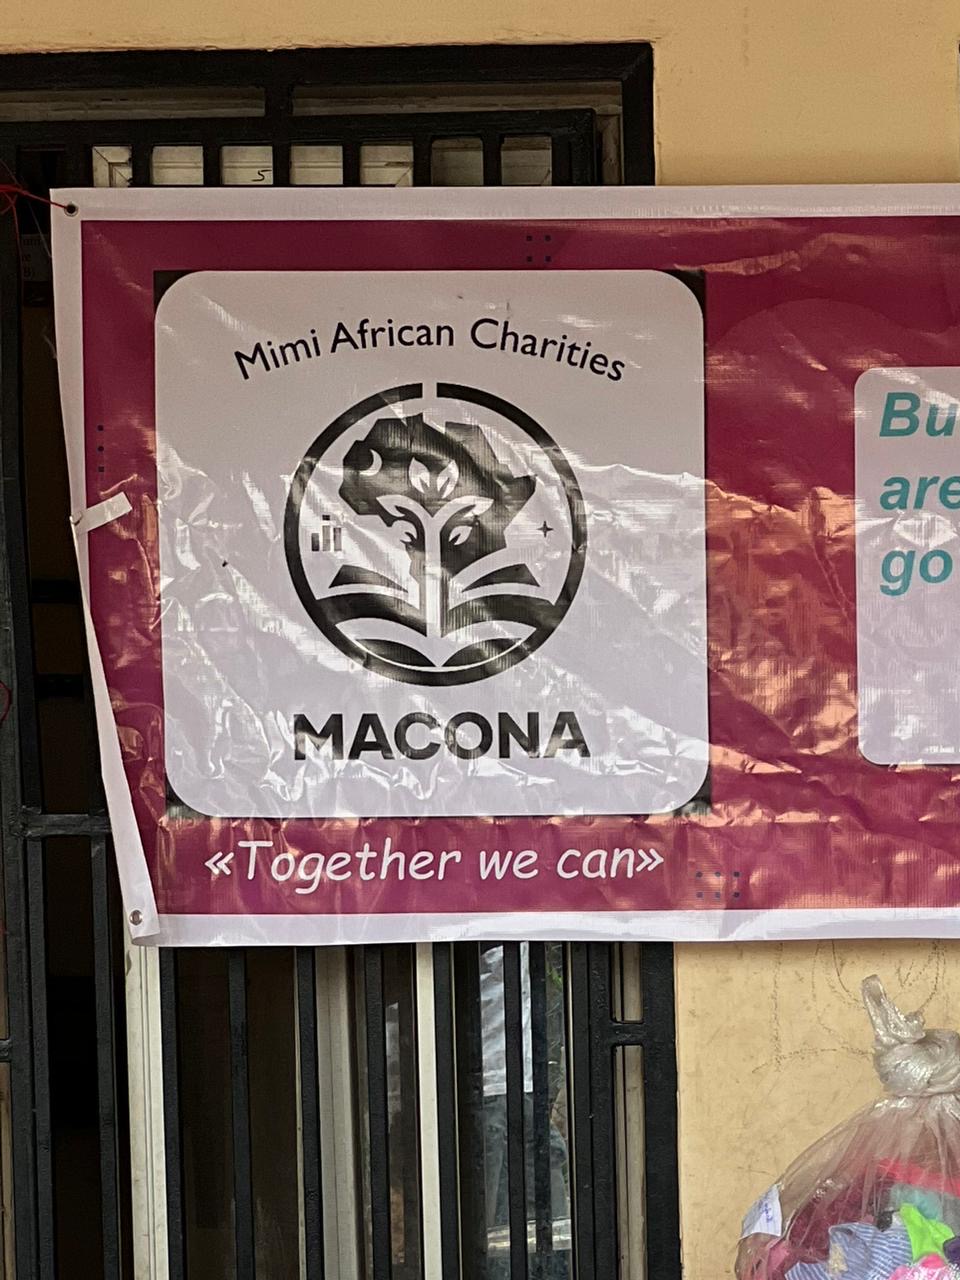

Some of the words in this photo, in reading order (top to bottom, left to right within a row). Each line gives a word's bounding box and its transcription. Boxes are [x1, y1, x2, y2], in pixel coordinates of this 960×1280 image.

[233, 330, 322, 380] Mimi
[331, 319, 455, 355] African
[470, 317, 627, 382] Charities
[879, 546, 954, 597] go
[293, 711, 591, 761] MACONA
[479, 849, 540, 880] we
